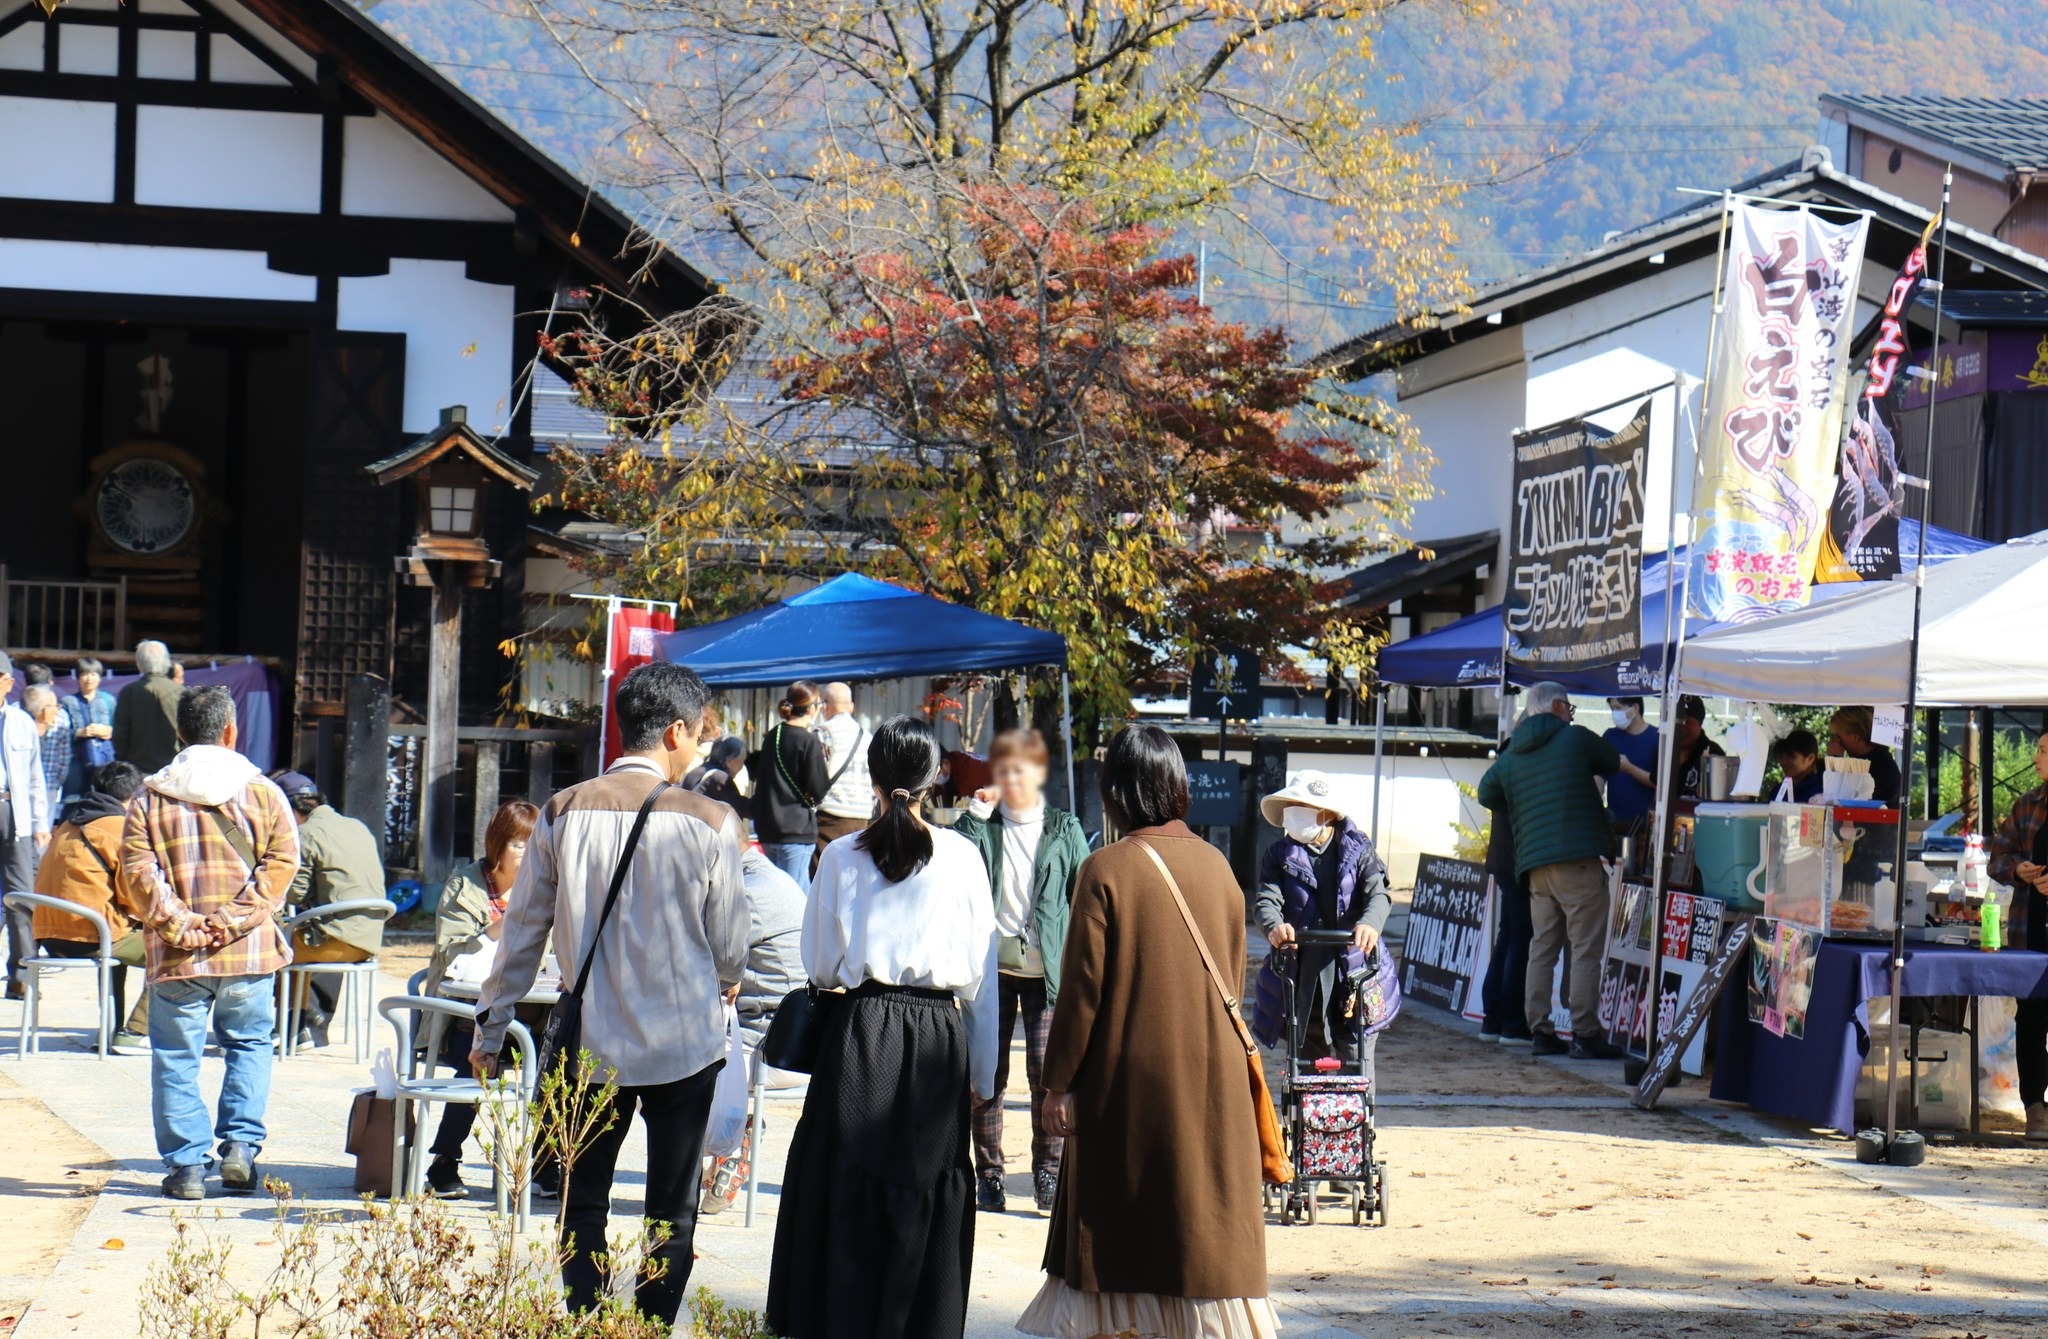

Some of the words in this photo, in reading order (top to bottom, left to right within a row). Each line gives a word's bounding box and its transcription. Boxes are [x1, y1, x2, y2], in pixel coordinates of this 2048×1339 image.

[1808, 238, 1853, 410] 富山湾の宝石
[1728, 236, 1821, 472] 白えび
[1706, 549, 1797, 574] 実演販売
[1736, 577, 1805, 600] のお店
[1694, 900, 1720, 918] TOYAMA
[1694, 917, 1715, 935] ブラック
[1404, 913, 1444, 968] TOYAMA
[1441, 922, 1481, 977] BLACK
